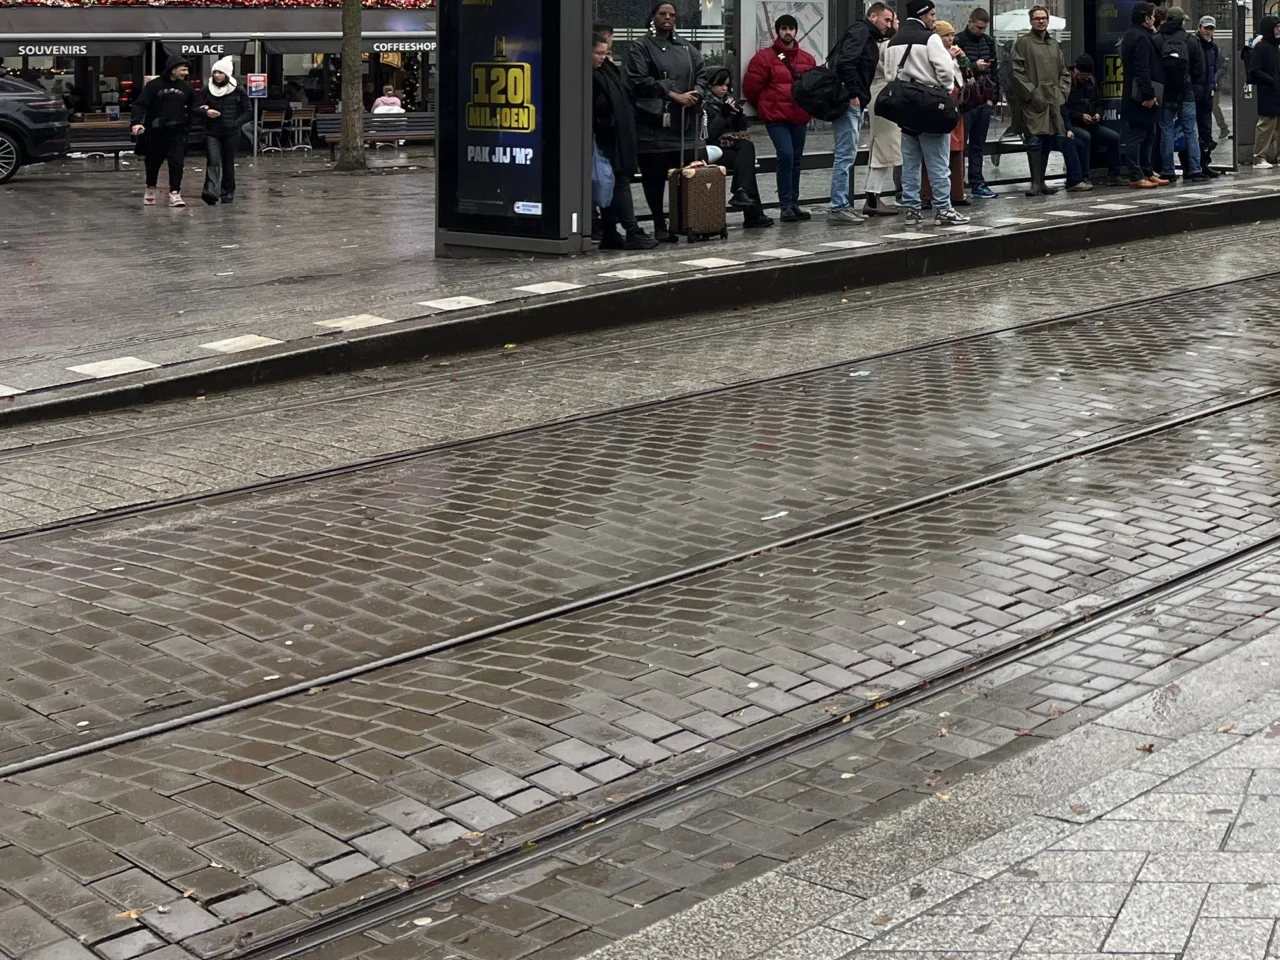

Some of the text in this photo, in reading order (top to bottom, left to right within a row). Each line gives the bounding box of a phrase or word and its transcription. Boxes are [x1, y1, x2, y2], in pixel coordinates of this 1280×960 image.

[18, 45, 87, 55] SOUVENIRS
[181, 44, 224, 54] PALACE
[373, 42, 437, 51] COFFEESHOP
[473, 67, 524, 105] 120
[468, 106, 529, 129] MILJOEN
[467, 145, 534, 165] PAK JIJ 'M?
